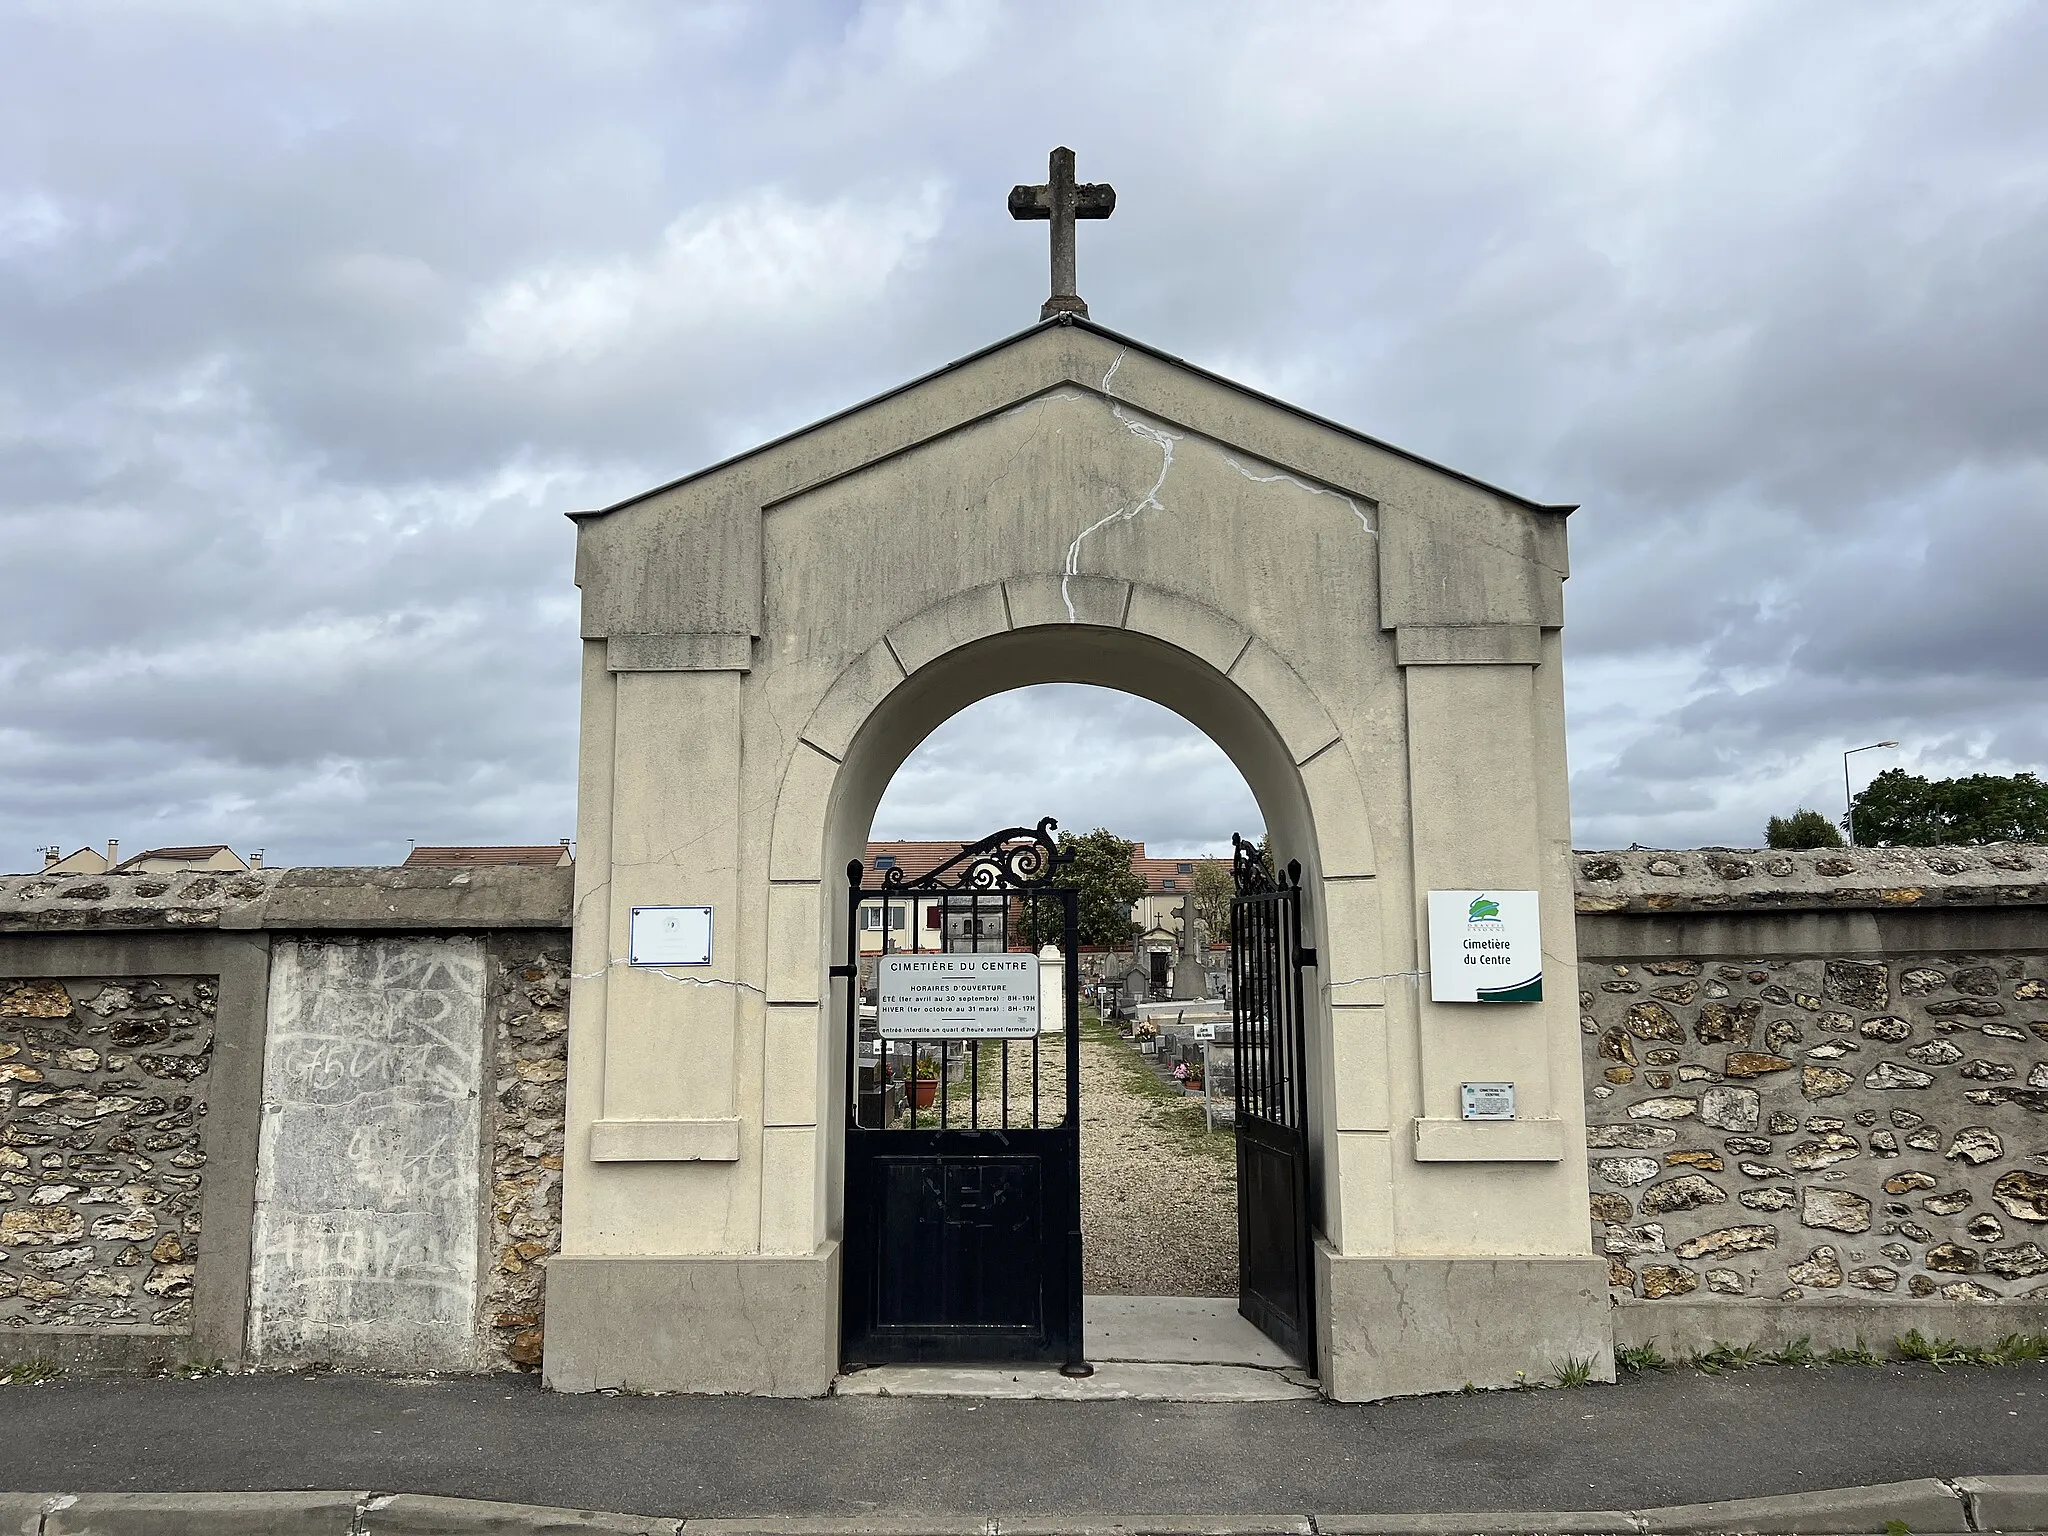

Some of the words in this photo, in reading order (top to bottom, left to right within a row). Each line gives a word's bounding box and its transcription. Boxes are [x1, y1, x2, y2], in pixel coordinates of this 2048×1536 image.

[1464, 938, 1510, 949] Cimetière
[1464, 954, 1476, 964] du
[1480, 955, 1510, 964] Centre
[890, 961, 954, 970] CIMETIÈRE
[982, 962, 1026, 970] CENTRE
